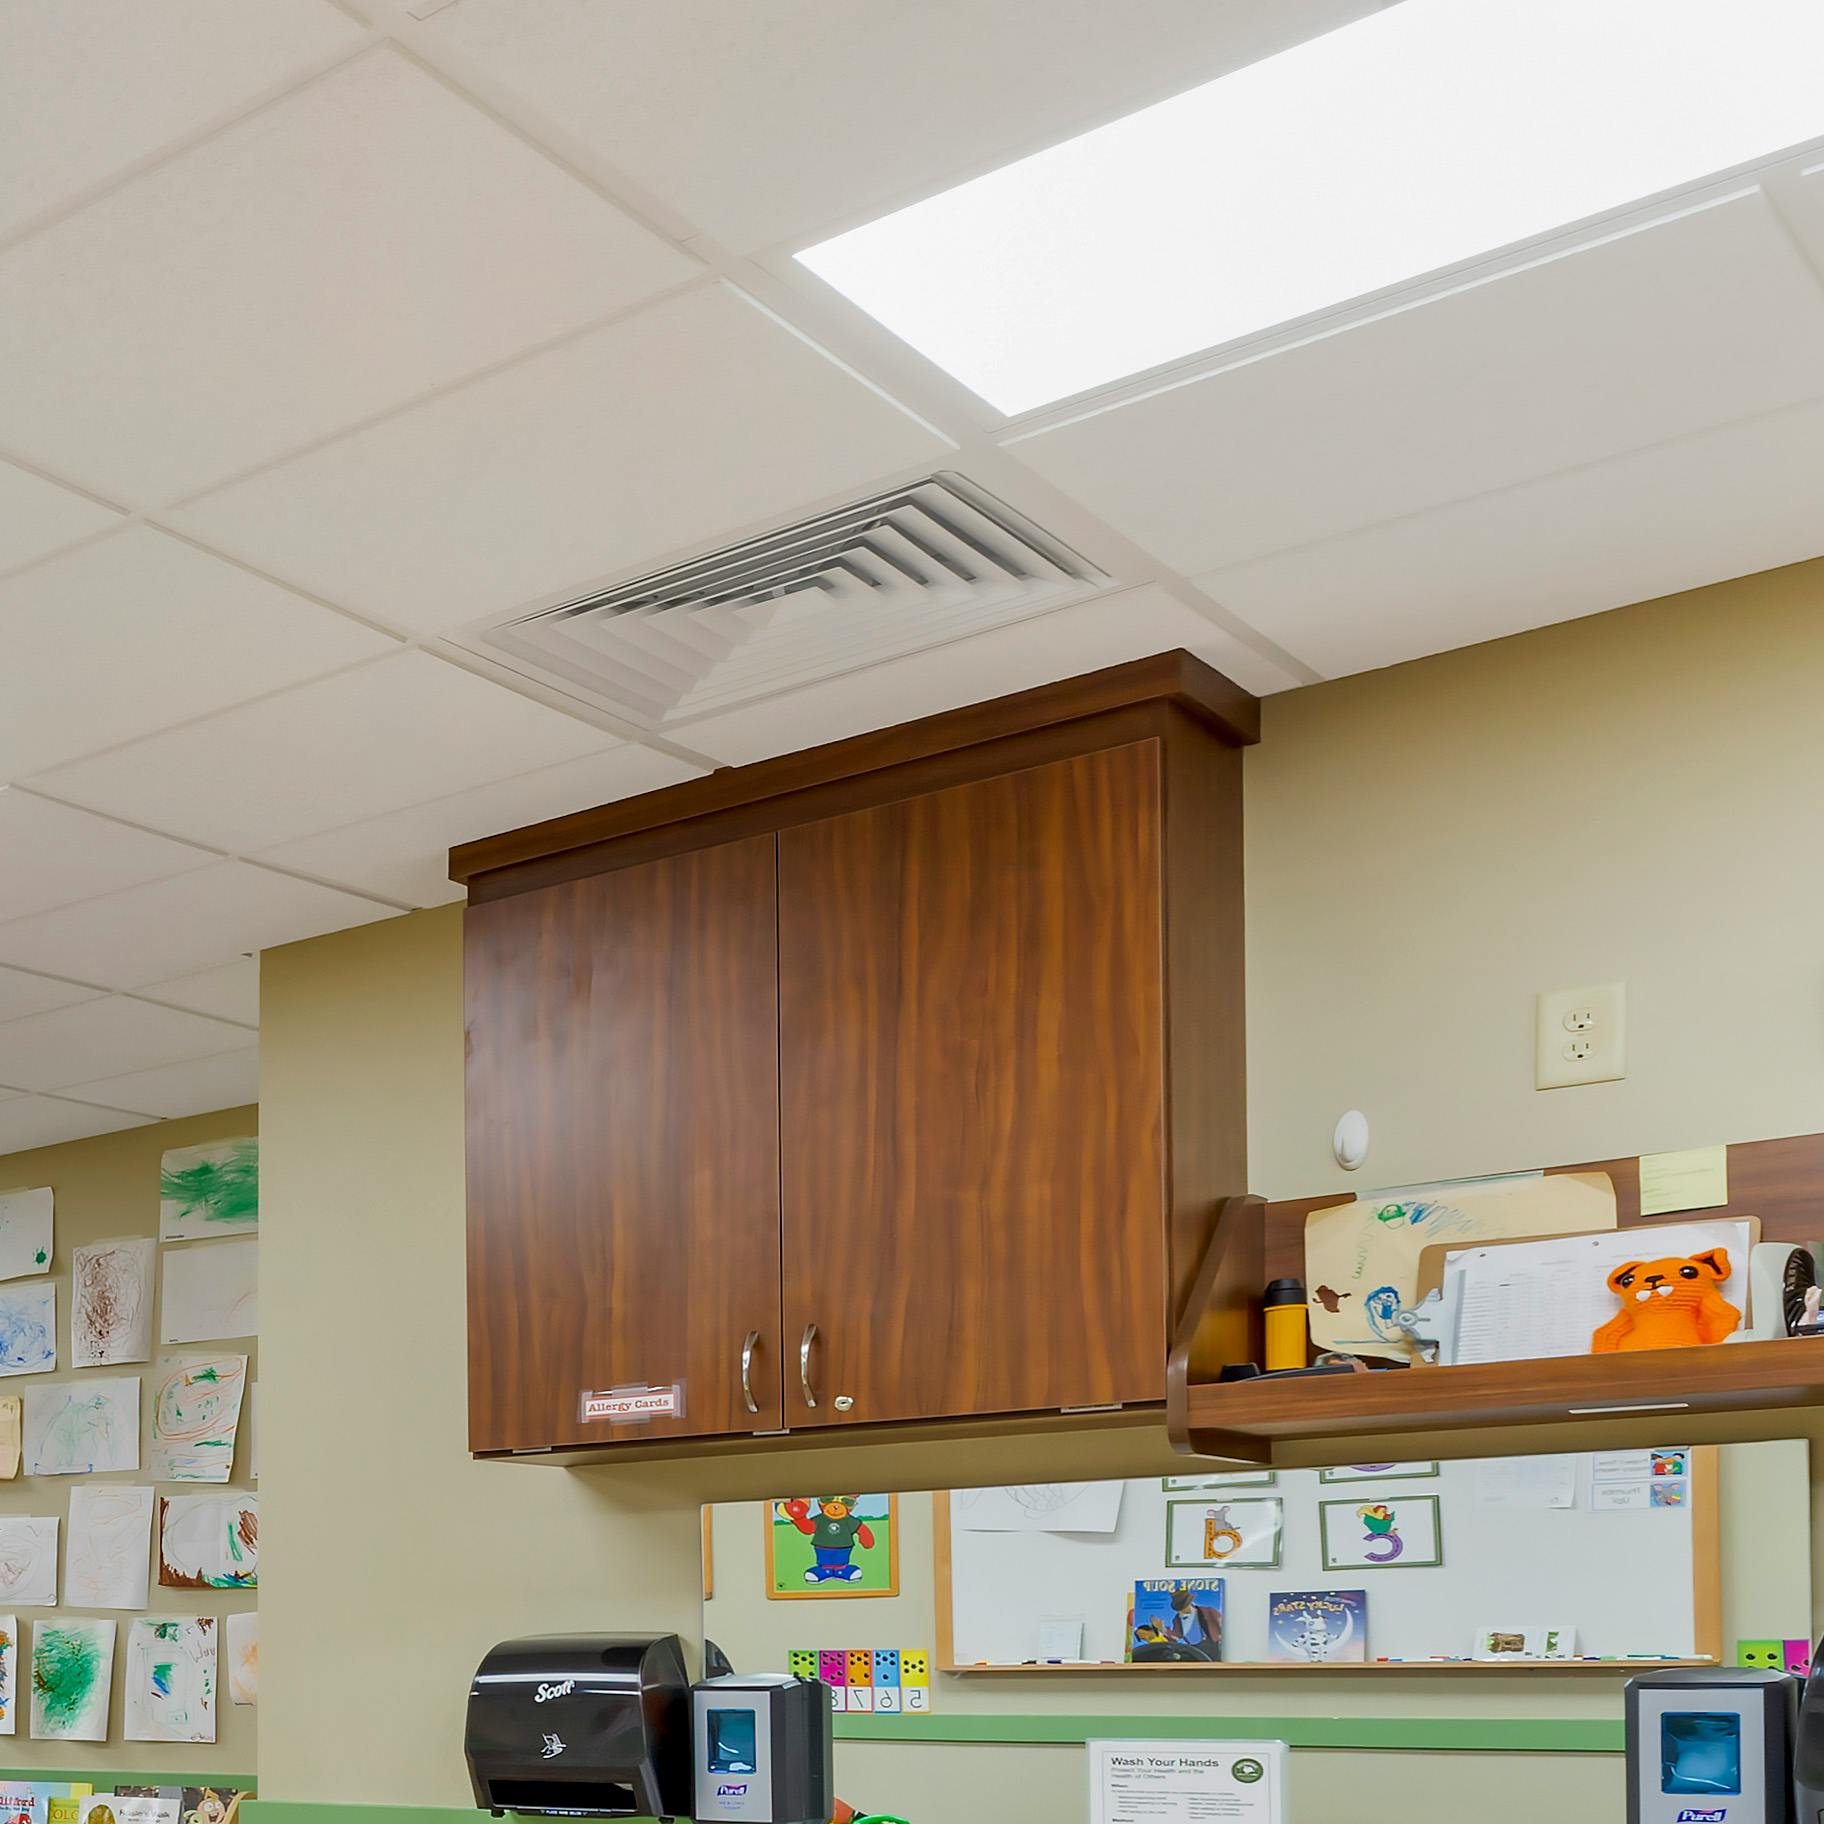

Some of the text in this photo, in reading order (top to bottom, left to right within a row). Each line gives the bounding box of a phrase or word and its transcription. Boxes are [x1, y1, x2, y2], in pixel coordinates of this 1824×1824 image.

[588, 1398, 669, 1412] Allergy Cards
[534, 1680, 575, 1703] Scott
[1111, 1757, 1219, 1767] Wash Your Hands
[719, 1785, 746, 1796] Purell
[1682, 1810, 1723, 1822] Purell
